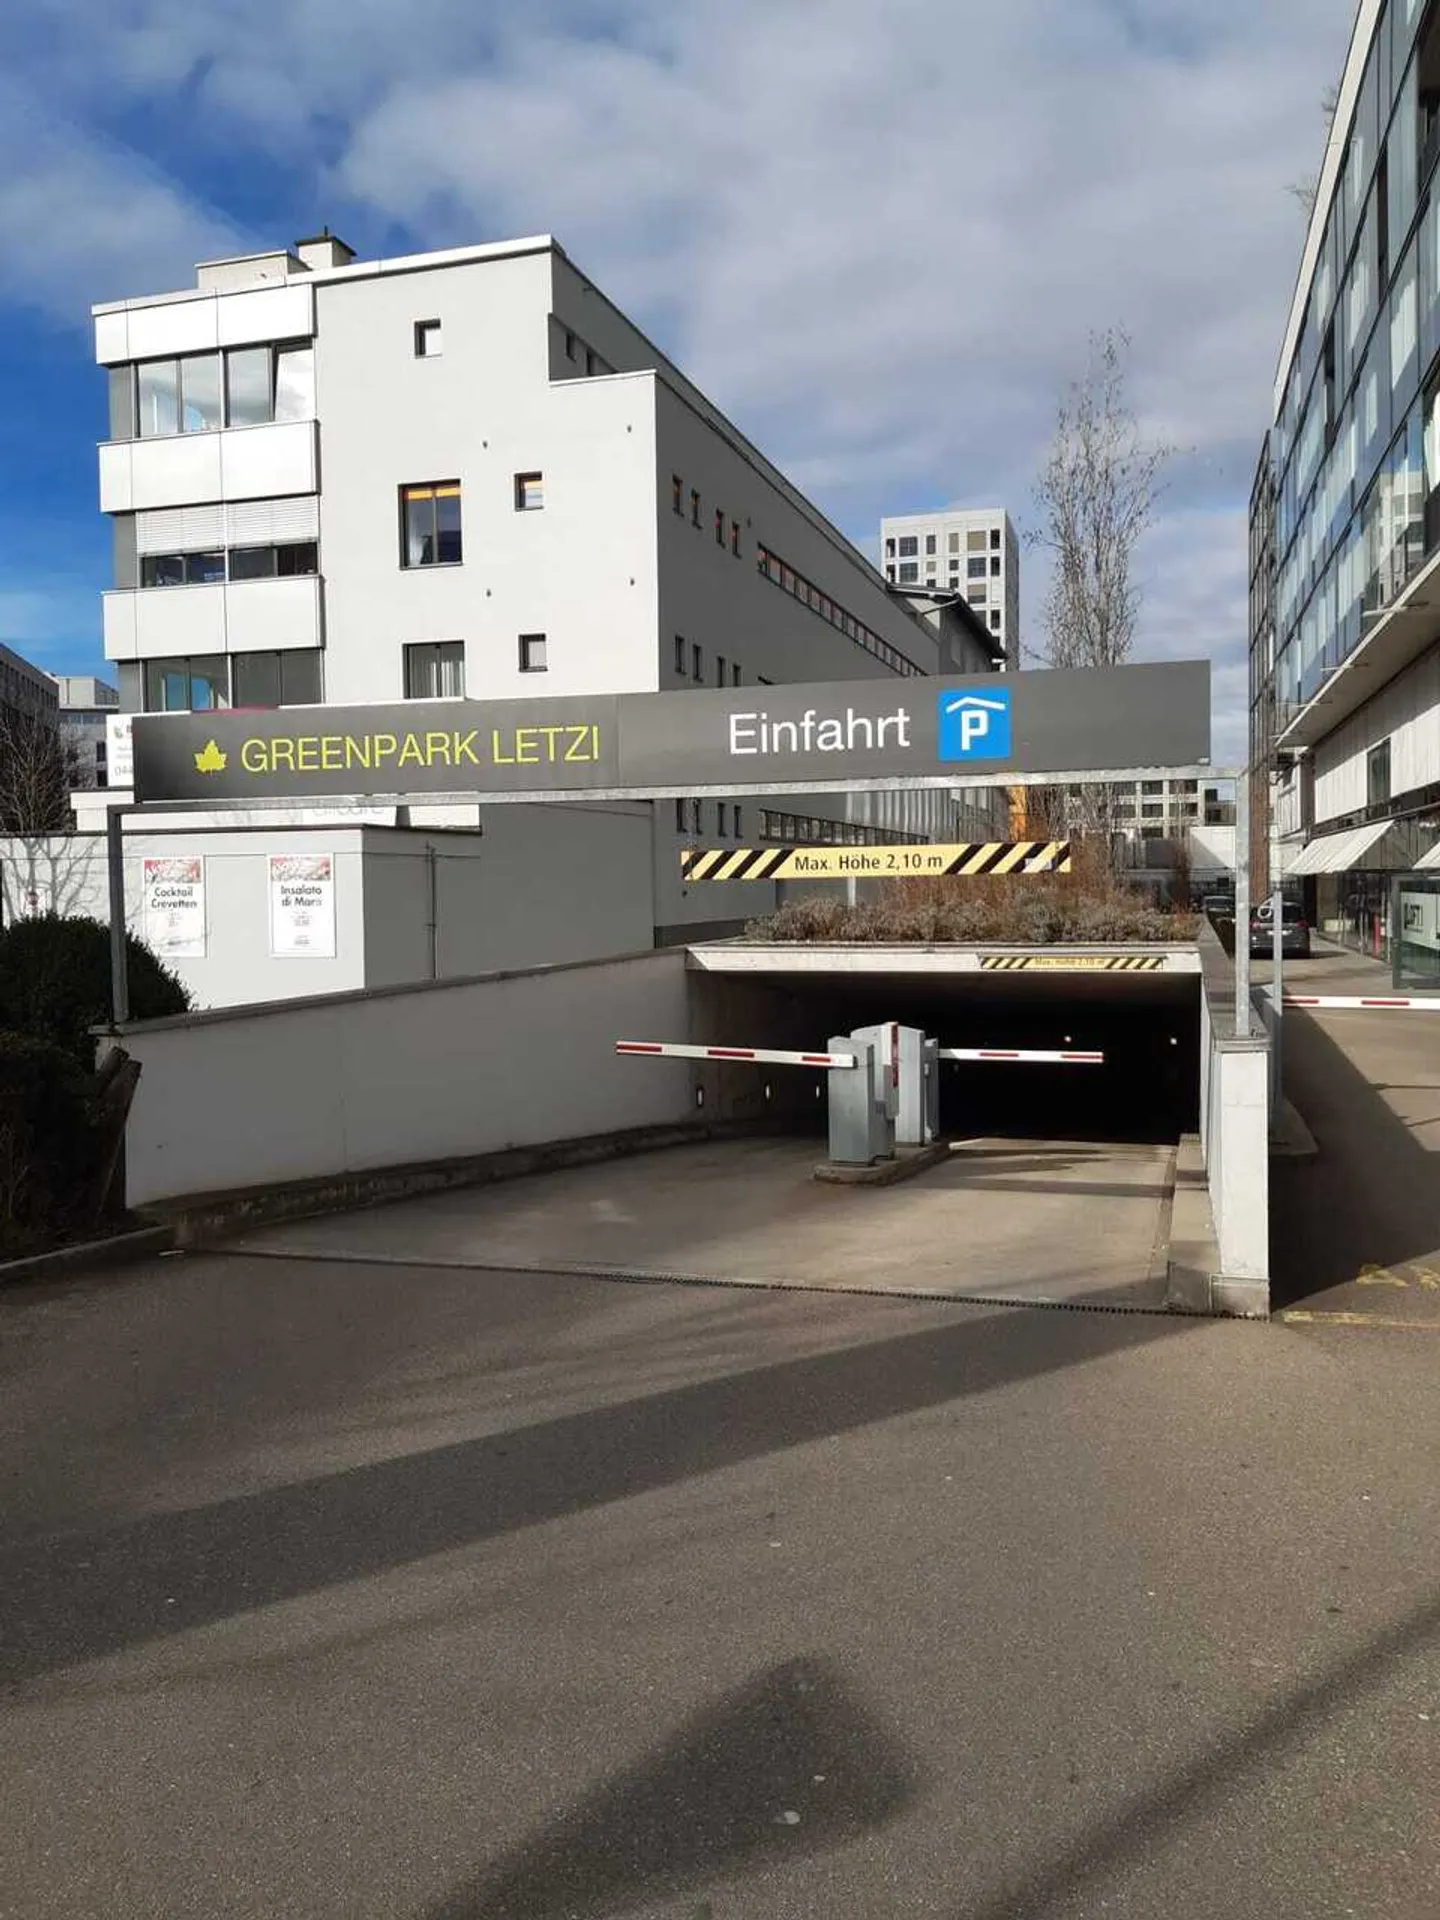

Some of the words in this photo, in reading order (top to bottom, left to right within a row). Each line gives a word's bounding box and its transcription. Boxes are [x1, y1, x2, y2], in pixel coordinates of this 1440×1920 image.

[729, 708, 910, 754] Einfahrt
[961, 710, 988, 750] P
[241, 730, 480, 772] GREENPARK
[493, 725, 599, 764] LETZI
[795, 856, 833, 870] Max.
[839, 854, 880, 869] Höhe
[886, 853, 922, 870] 2,10
[928, 855, 943, 868] m
[154, 886, 193, 897] Cocktail
